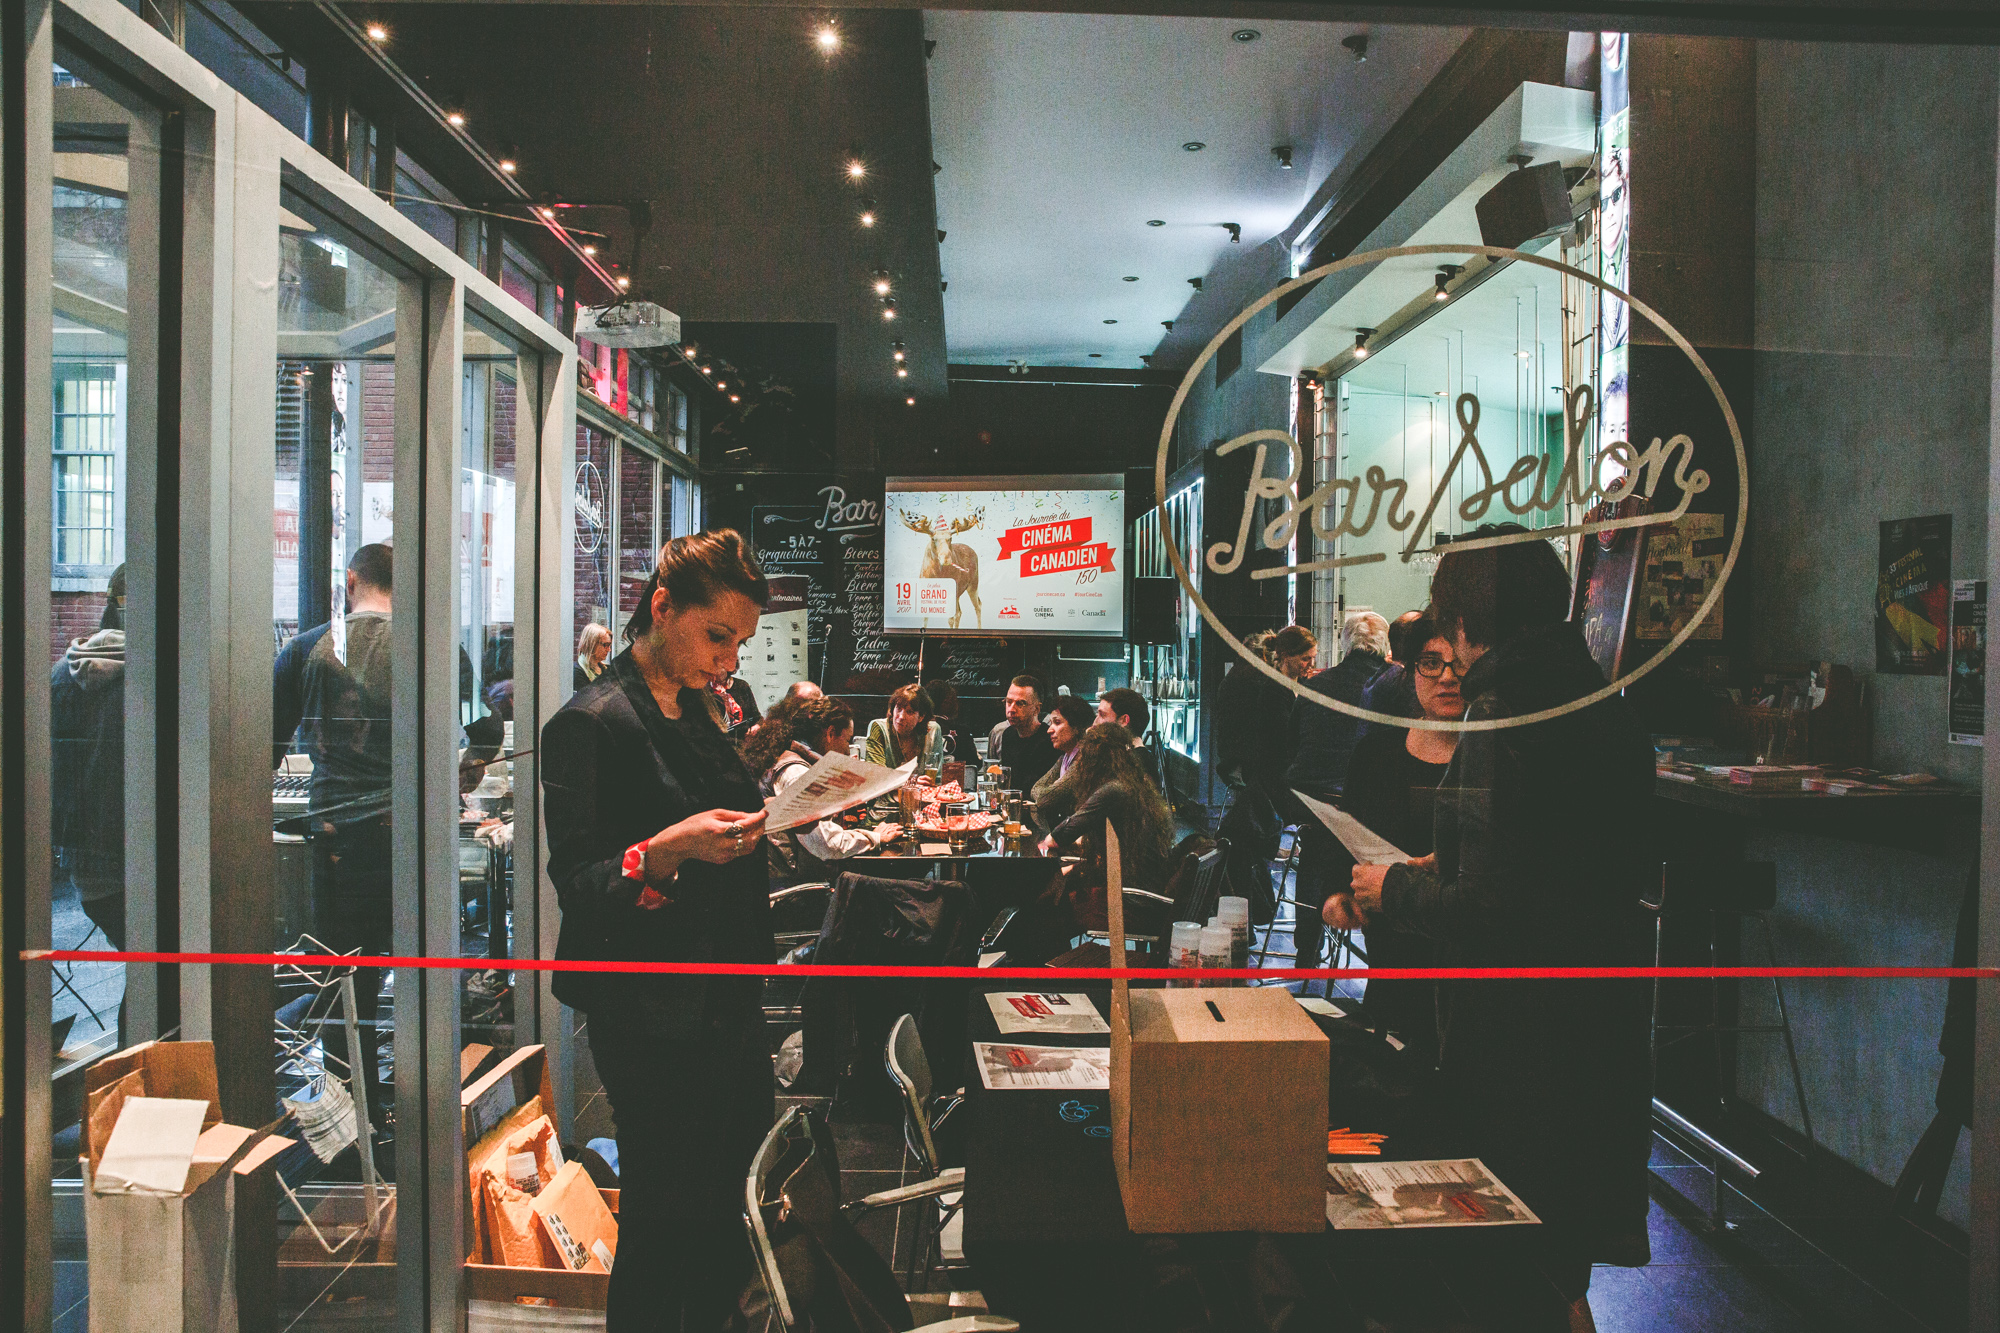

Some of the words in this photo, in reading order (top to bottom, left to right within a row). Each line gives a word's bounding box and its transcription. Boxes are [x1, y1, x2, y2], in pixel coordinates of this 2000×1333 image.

[1206, 429, 1414, 575] Bar
[1403, 384, 1711, 562] Salon
[814, 485, 879, 530] Bar
[1012, 517, 1024, 527] La
[1025, 512, 1058, 526] Journée
[1058, 509, 1072, 521] du
[1022, 524, 1073, 548] CINÉMA
[757, 548, 818, 565] Grignotines
[843, 546, 880, 560] Bières
[1030, 547, 1098, 572] CANADIEN
[844, 579, 878, 592] Bière
[1075, 568, 1098, 586] 150
[896, 582, 912, 599] 19
[920, 589, 948, 600] GRAND
[896, 606, 912, 614] 2017
[1081, 609, 1107, 617] Canada
[855, 636, 891, 650] Cidre
